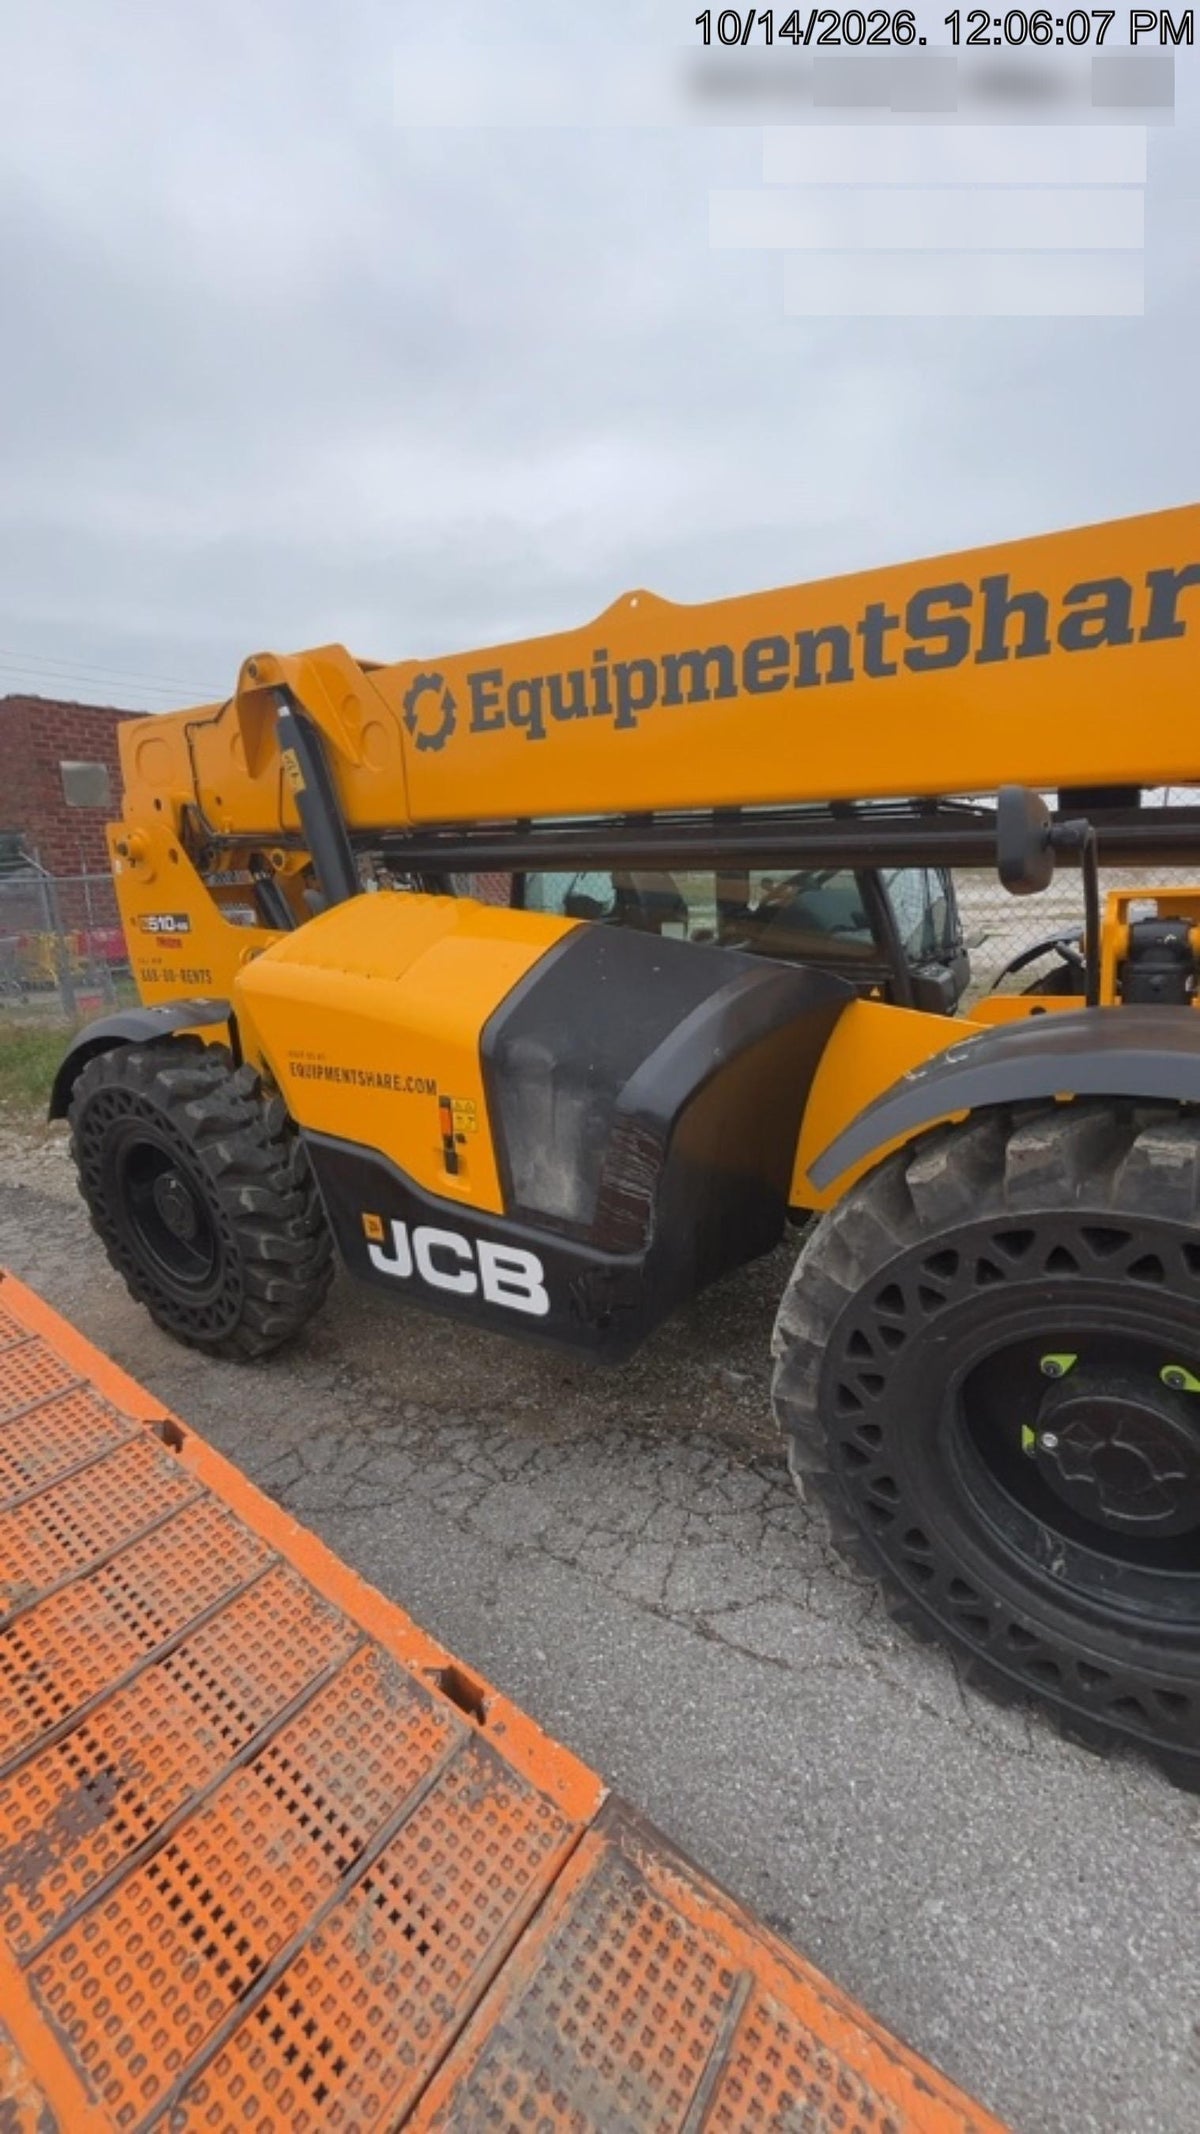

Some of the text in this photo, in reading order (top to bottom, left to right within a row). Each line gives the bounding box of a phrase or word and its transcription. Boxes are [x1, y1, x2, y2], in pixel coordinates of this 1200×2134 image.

[467, 562, 1200, 741] EquipmentShar
[289, 1062, 438, 1096] EQUIPMENTSHARE.COM
[367, 1218, 550, 1316] JCB
